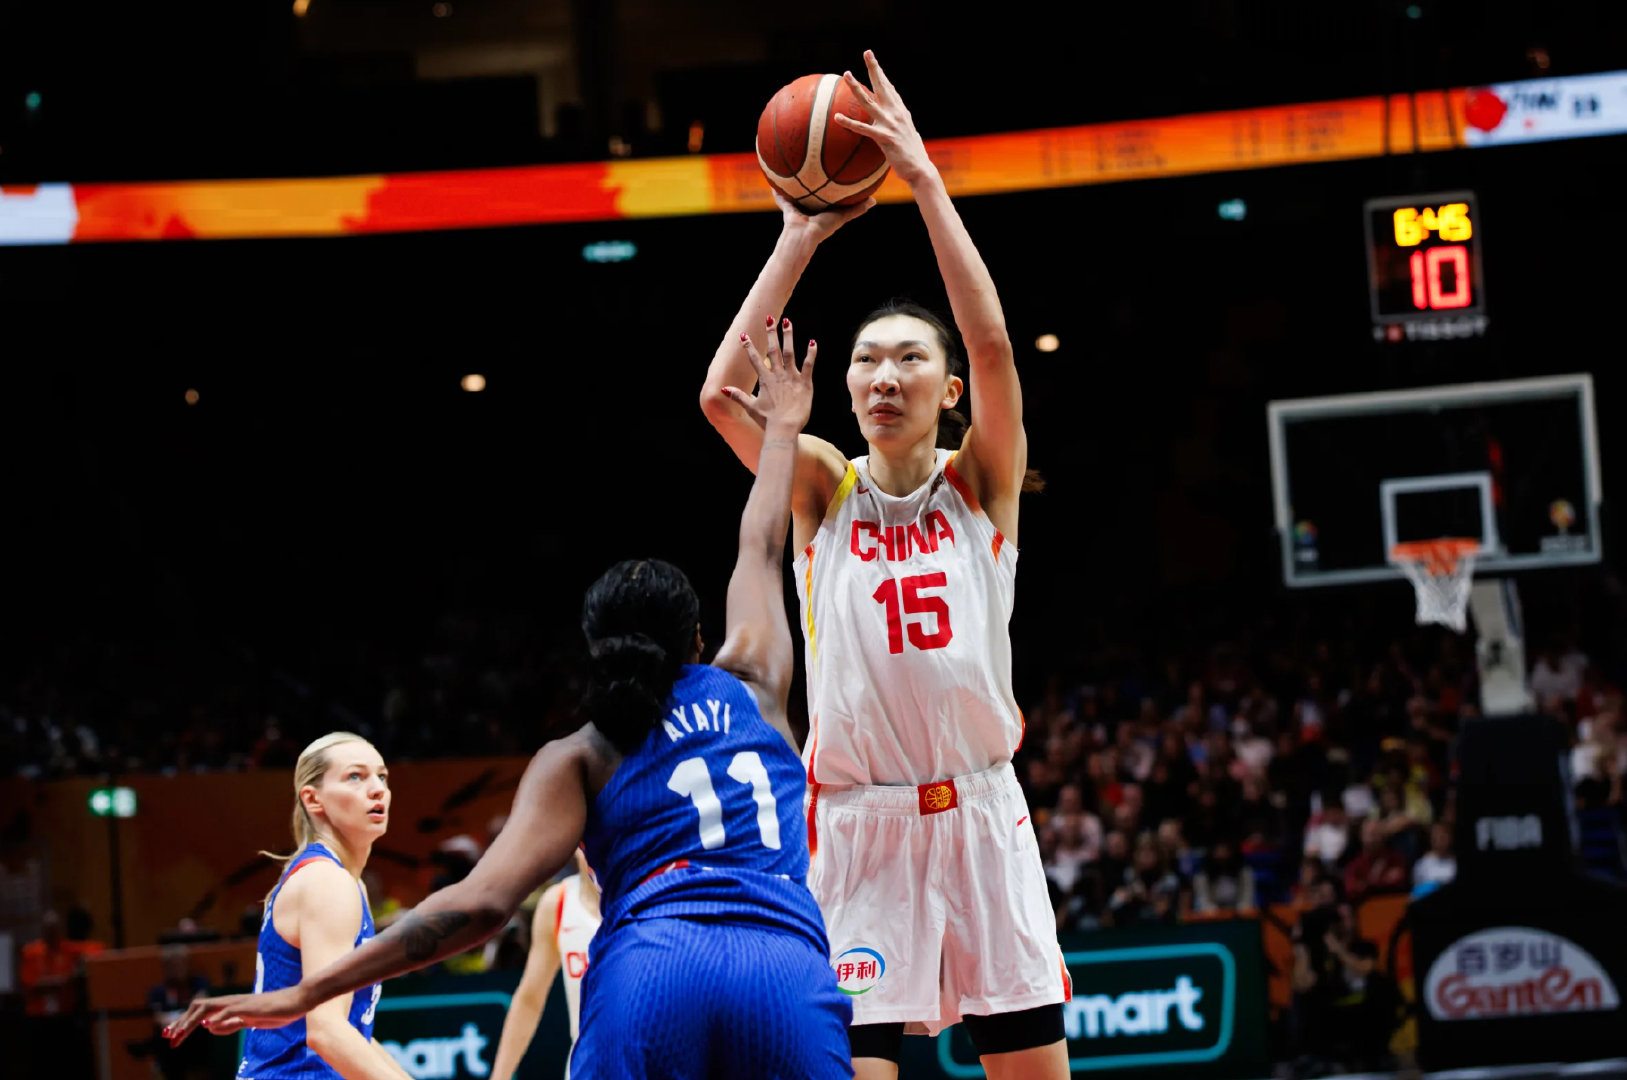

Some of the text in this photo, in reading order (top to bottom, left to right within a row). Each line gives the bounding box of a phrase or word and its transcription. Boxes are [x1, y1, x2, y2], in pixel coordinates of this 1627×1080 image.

[1410, 245, 1472, 310] 10
[850, 509, 955, 562] CHINA
[872, 571, 953, 655] 15
[662, 699, 731, 743] AYAYI
[667, 751, 781, 850] 11
[836, 960, 877, 983] 伊利
